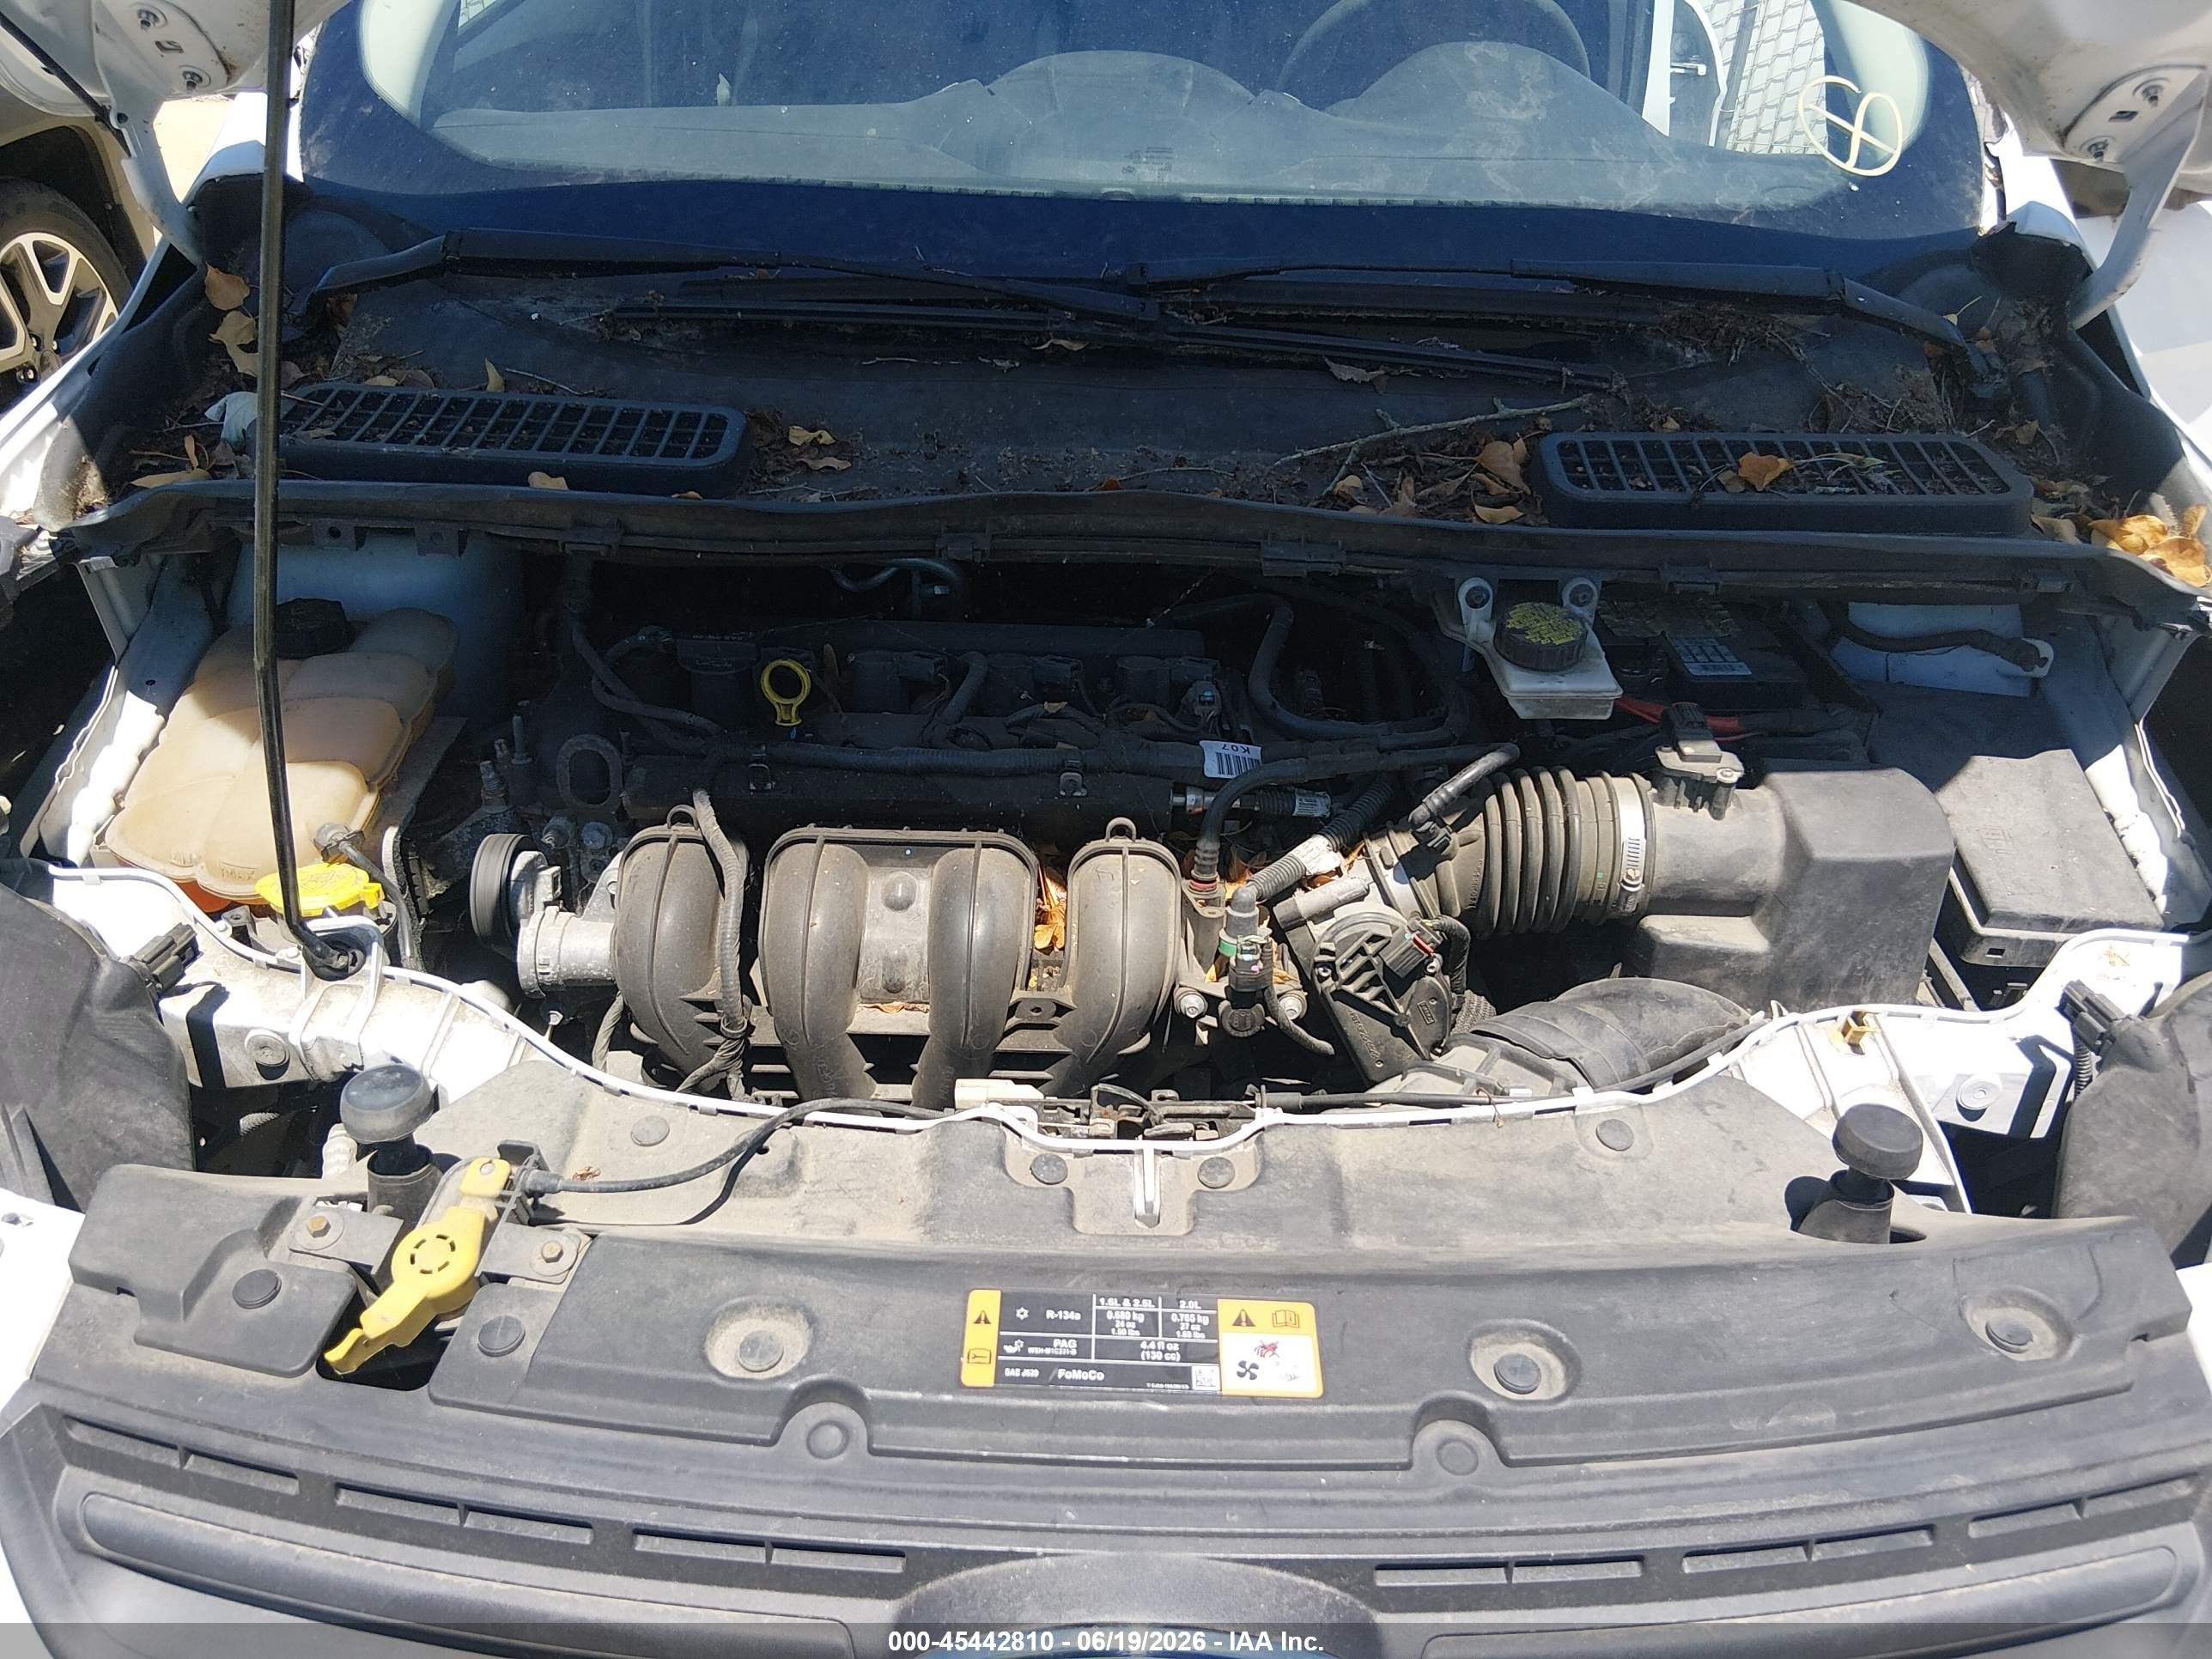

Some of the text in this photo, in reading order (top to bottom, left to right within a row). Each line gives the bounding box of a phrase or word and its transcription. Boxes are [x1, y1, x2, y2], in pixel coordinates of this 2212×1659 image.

[1221, 743, 1250, 754] K07
[1122, 1297, 1131, 1307] &
[1179, 1299, 1202, 1310] 2.0L
[1046, 1310, 1081, 1320] R-134a
[1132, 1311, 1145, 1323] kg
[1196, 1314, 1209, 1326] kg
[1053, 1339, 1077, 1349] PAG
[1140, 1340, 1156, 1350] 4.4
[1166, 1342, 1180, 1352] oz
[1140, 1351, 1164, 1361] (130
[1057, 1368, 1105, 1381] FoMoCo
